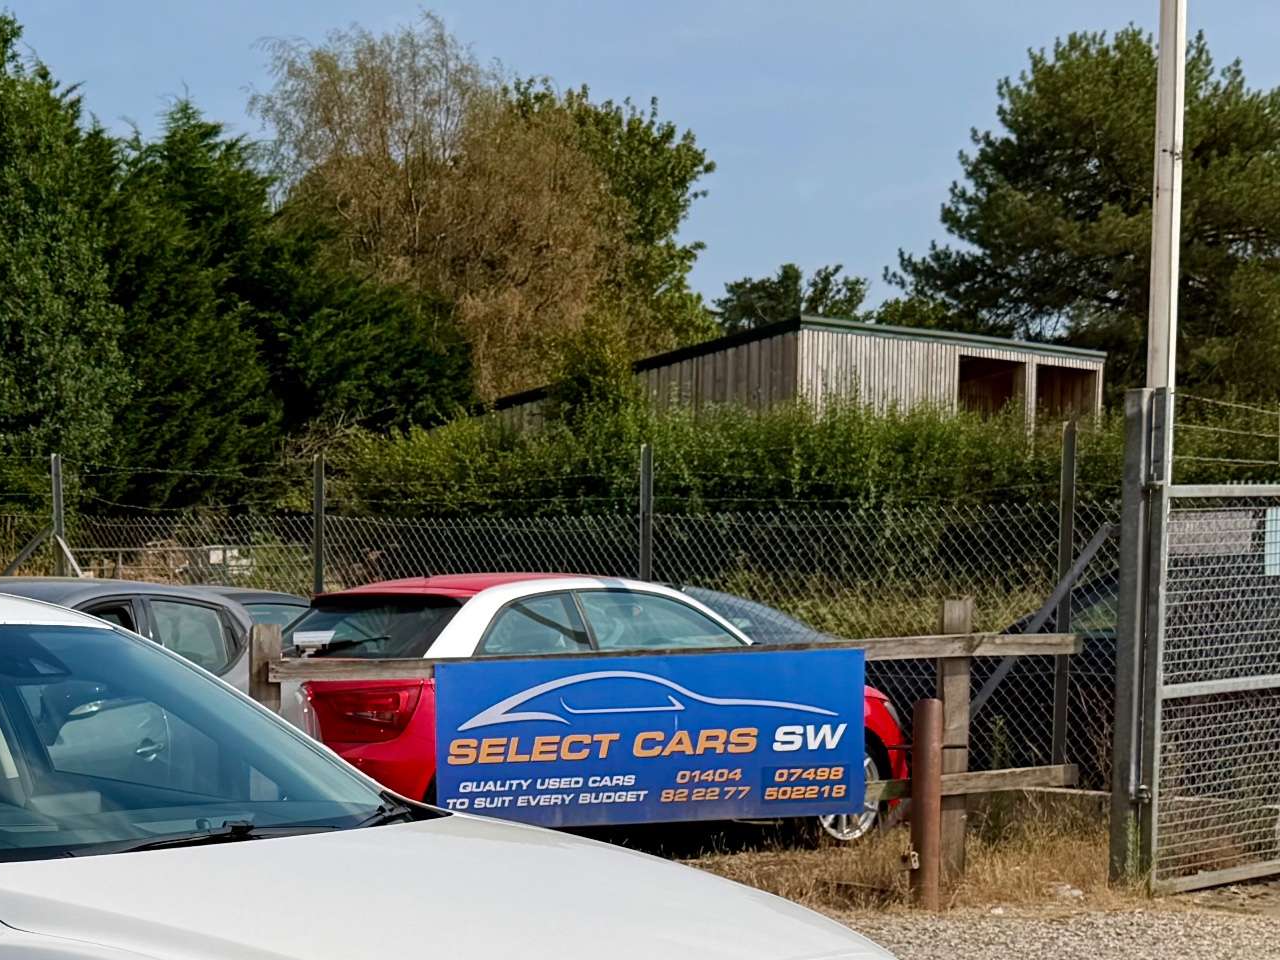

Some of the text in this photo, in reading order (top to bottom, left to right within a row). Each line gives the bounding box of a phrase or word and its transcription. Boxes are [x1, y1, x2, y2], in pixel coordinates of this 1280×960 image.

[447, 723, 848, 766] SELECT CARS SW
[458, 774, 636, 793] QUALITY USED CARS
[676, 768, 742, 784] 01404
[446, 790, 649, 810] TO SUIT EVERY BUDGET
[764, 784, 848, 801] 502218
